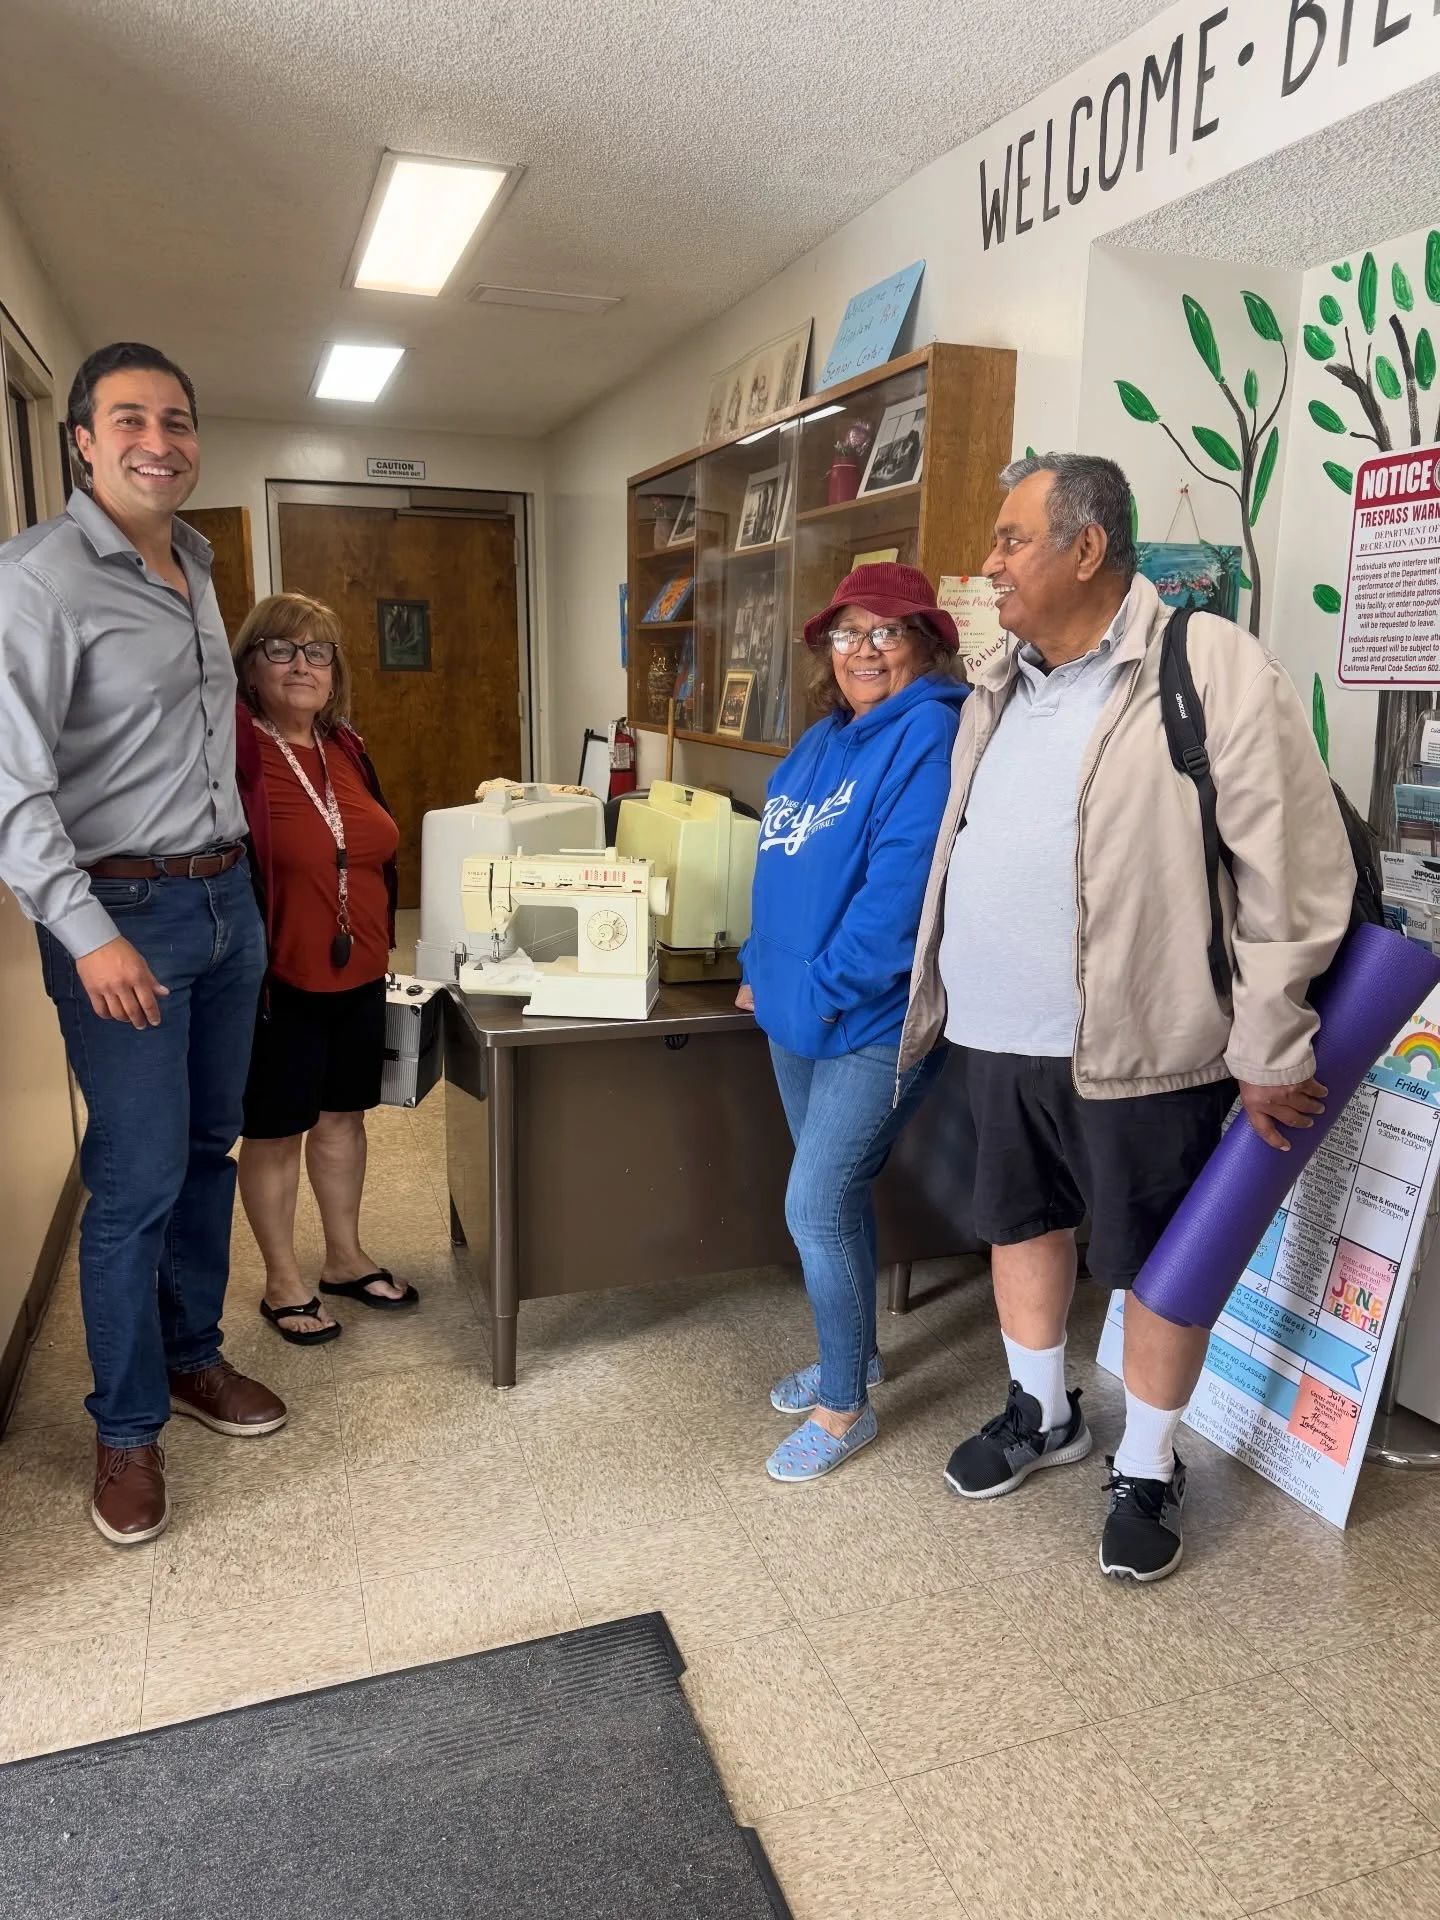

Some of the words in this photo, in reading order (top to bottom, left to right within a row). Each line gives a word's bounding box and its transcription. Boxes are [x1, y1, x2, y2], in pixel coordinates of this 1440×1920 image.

[979, 6, 1229, 250] WELCOME
[376, 461, 414, 470] CAUTION
[1361, 459, 1433, 500] NOTICE
[1361, 506, 1408, 528] TRESPASS
[1374, 525, 1426, 540] DEPARTMENT
[1428, 523, 1440, 533] OF
[1360, 538, 1407, 552] RECREATION
[1408, 536, 1426, 547] AND
[1356, 560, 1387, 571] Individuals
[1388, 560, 1400, 569] who
[1401, 558, 1428, 567] interfere
[1352, 571, 1382, 582] employees
[1383, 571, 1390, 579] of
[1390, 570, 1400, 578] the
[1402, 567, 1437, 579] Department
[1358, 582, 1394, 592] performance
[1402, 580, 1416, 588] their
[1355, 591, 1378, 601] obstruct
[1386, 589, 1415, 599] intimidate
[1417, 588, 1440, 599] patrons
[1355, 602, 1366, 610] this
[1396, 600, 1411, 608] enter
[1358, 612, 1374, 620] areas
[1375, 610, 1395, 619] without
[1360, 621, 1370, 629] will
[1370, 621, 1378, 629] be
[1379, 620, 1409, 630] requested
[1410, 620, 1417, 628] to
[1348, 635, 1379, 644] Individuals
[1380, 634, 1404, 644] refusing
[1405, 634, 1412, 642] to
[1412, 633, 1430, 642] leave
[966, 636, 1006, 672] Potluck
[1351, 645, 1365, 653] such
[1366, 645, 1388, 654] request
[1389, 644, 1399, 653] will
[1400, 644, 1408, 652] be
[1409, 643, 1432, 654] subject
[1432, 643, 1440, 652] to
[1352, 655, 1369, 663] arrest
[1381, 654, 1417, 664] prosecution
[1418, 654, 1437, 662] under
[1343, 664, 1370, 672] California
[1370, 664, 1387, 672] Penal
[1388, 664, 1404, 672] Code
[1404, 664, 1427, 672] Section
[1407, 916, 1427, 930] Bread
[1395, 1078, 1430, 1101] Friday
[1432, 1110, 1440, 1120] 5
[1376, 1119, 1399, 1132] Crochet
[1407, 1131, 1432, 1146] Knitting
[1347, 1162, 1357, 1173] 11
[1405, 1185, 1416, 1197] 12
[1354, 1186, 1378, 1201] Crochet
[1378, 1196, 1383, 1204] &
[1384, 1199, 1409, 1216] Knitting
[1328, 1235, 1340, 1246] 18
[1387, 1263, 1398, 1274] 19
[1256, 1283, 1267, 1293] 24
[1332, 1277, 1380, 1317] JUNE
[1235, 1297, 1245, 1306] the
[1246, 1303, 1268, 1319] Summer
[1308, 1308, 1320, 1320] 25
[1330, 1296, 1378, 1333] TEENTH
[1243, 1292, 1279, 1316] CLASSES
[1281, 1314, 1305, 1331] (Week
[1308, 1329, 1316, 1338] 1)
[1249, 1317, 1261, 1328] July
[1266, 1326, 1281, 1338] 2026
[1365, 1341, 1377, 1352] 26
[1210, 1343, 1229, 1358] BREAK
[1229, 1356, 1239, 1364] NO
[1239, 1362, 1266, 1381] CLASSES
[1234, 1375, 1245, 1386] July
[1251, 1385, 1265, 1398] 2026
[1327, 1388, 1345, 1406] July
[1349, 1404, 1357, 1418] 3
[1256, 1416, 1266, 1427] LOS
[1299, 1416, 1336, 1446] Independence
[1319, 1438, 1338, 1451] Day
